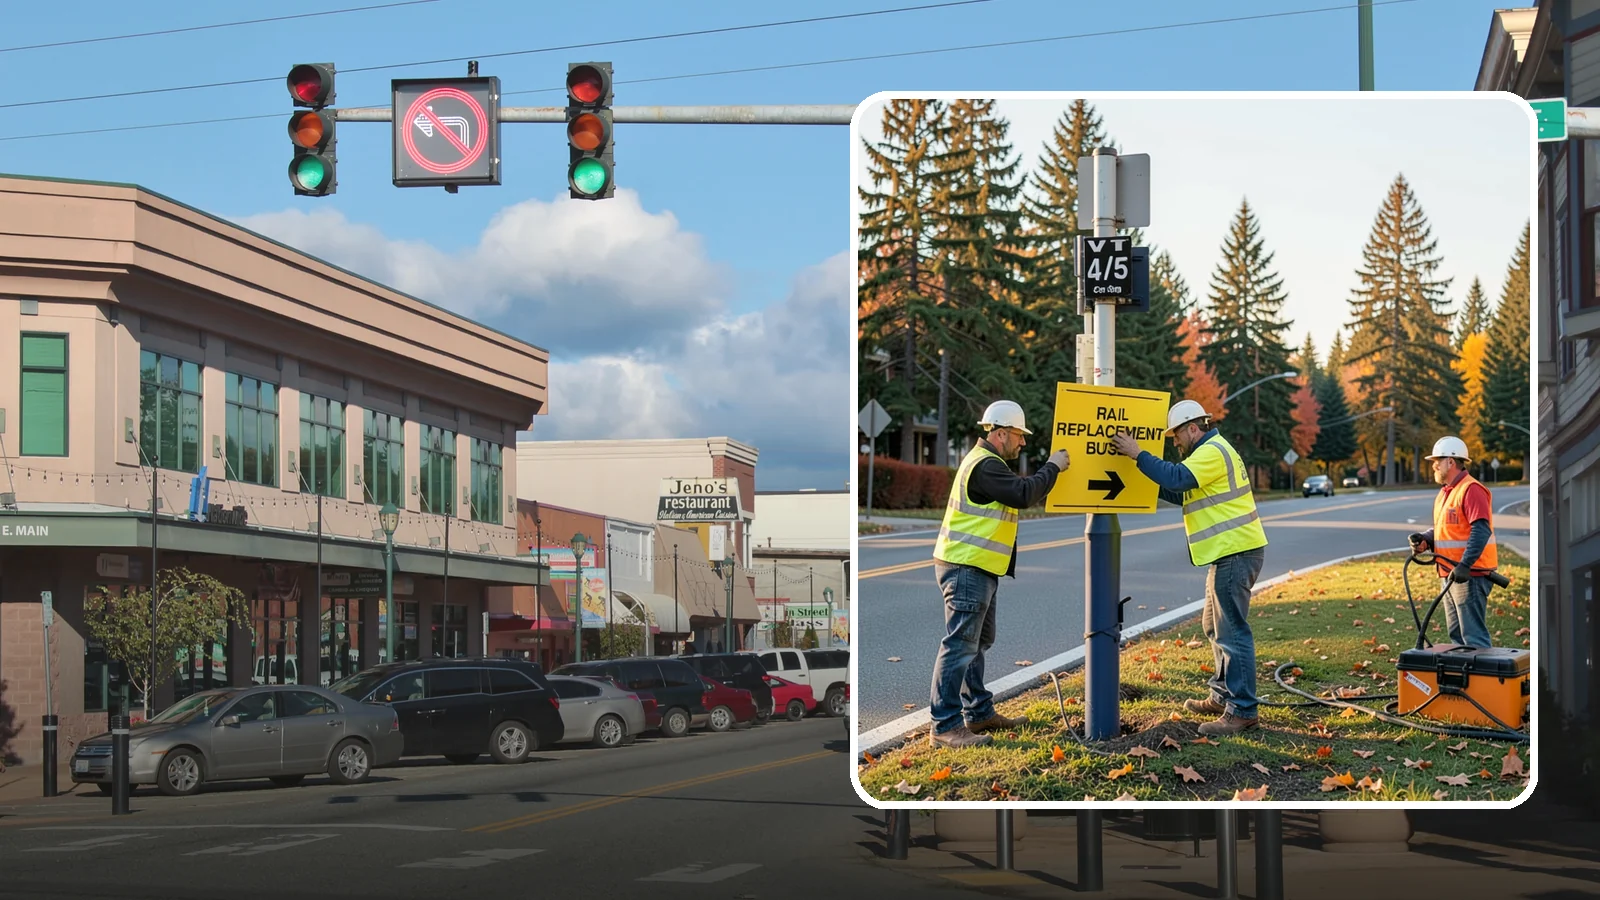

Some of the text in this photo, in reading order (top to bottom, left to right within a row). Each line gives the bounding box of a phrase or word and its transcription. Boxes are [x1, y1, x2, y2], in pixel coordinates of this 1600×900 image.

[1087, 255, 1129, 281] 4/5
[1096, 406, 1129, 421] RAIL
[1056, 422, 1164, 441] REPLACEMENT
[1085, 441, 1128, 456] BUS
[670, 480, 728, 494] Jeno's
[665, 497, 730, 508] restaurant
[659, 510, 682, 519] Italian
[685, 509, 715, 519] American
[715, 509, 737, 519] Cuisine
[2, 525, 49, 536] E. MAIN
[797, 607, 828, 617] Street
